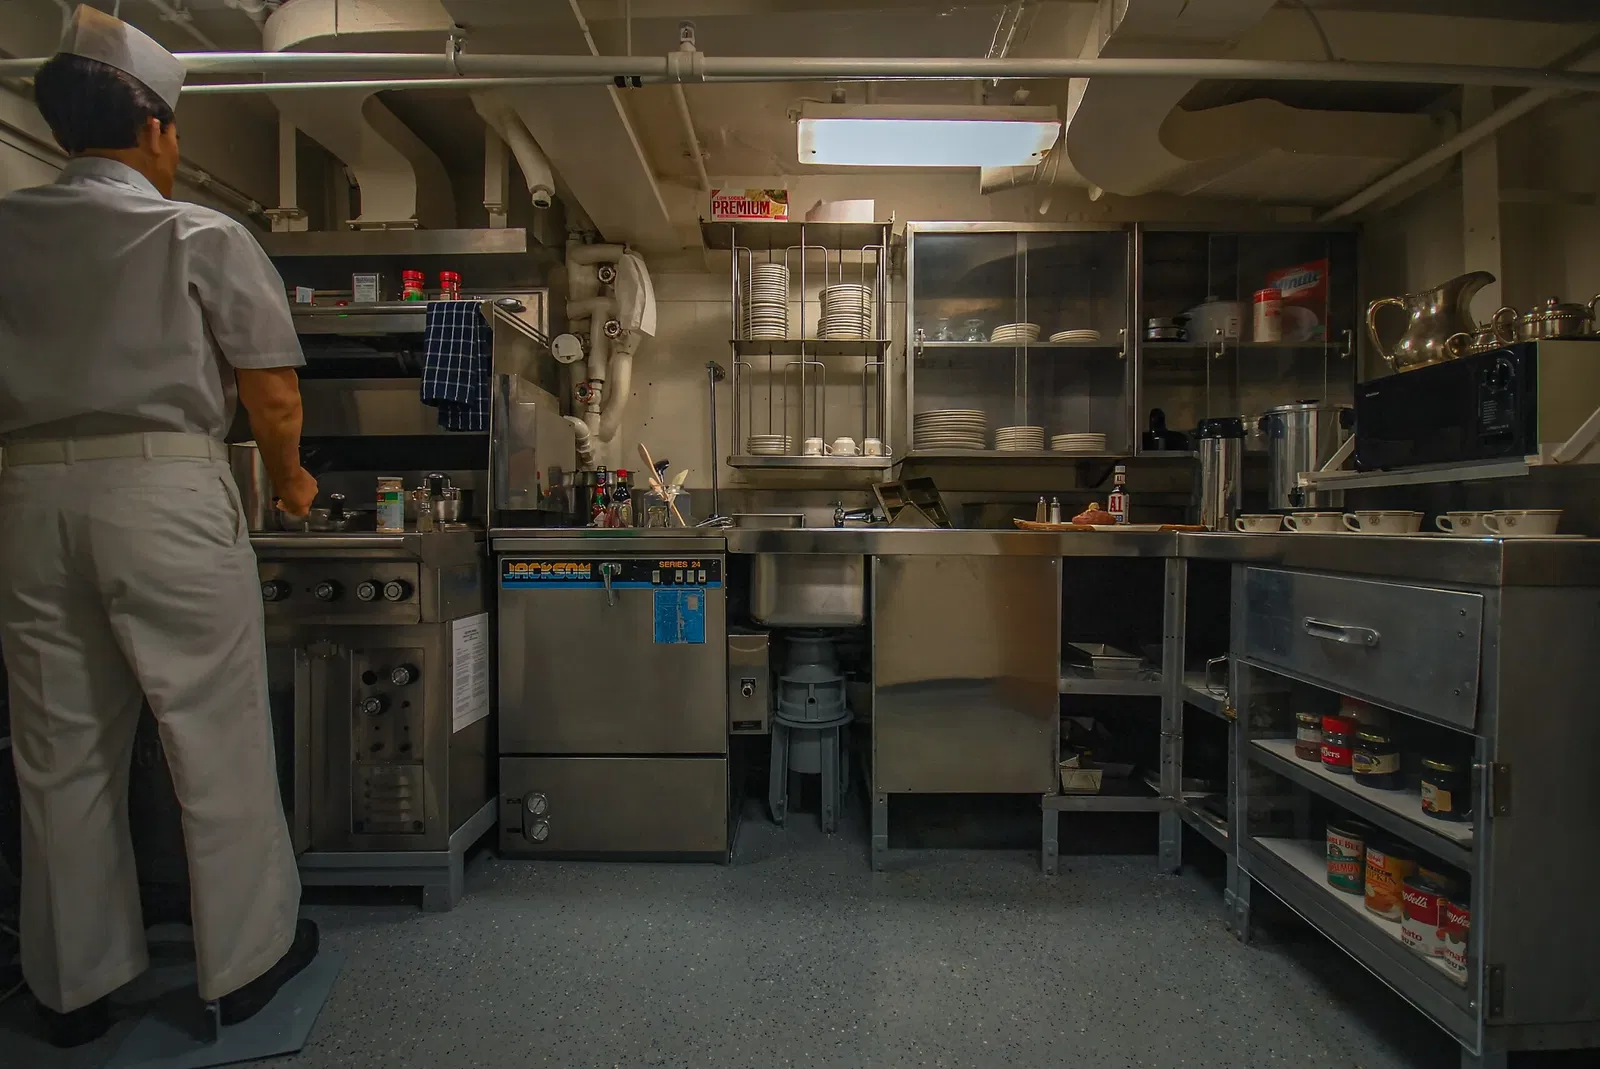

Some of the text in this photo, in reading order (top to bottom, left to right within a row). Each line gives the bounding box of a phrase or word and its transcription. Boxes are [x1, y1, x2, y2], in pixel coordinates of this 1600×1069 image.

[712, 200, 770, 215] PREMIUM
[503, 562, 591, 580] JACKSON
[658, 560, 702, 568] SERIES 24
